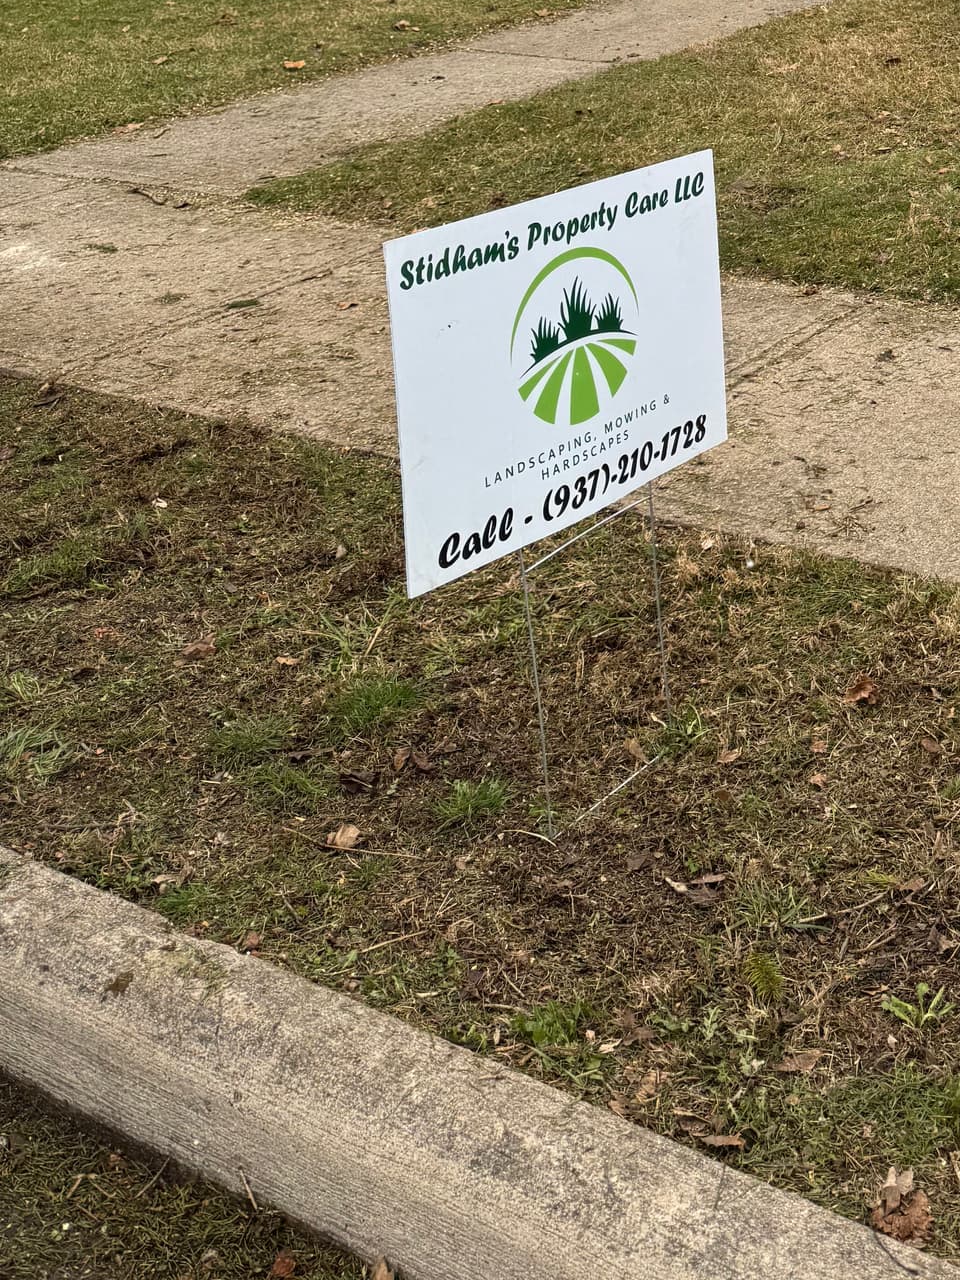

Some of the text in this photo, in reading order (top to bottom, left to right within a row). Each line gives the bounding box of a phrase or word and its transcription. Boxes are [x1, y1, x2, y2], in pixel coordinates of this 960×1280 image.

[399, 171, 705, 290] Stidham's Property Care LLC
[438, 507, 514, 569] Call
[542, 414, 707, 522] (937)-210-1728
[484, 393, 671, 488] LANDSCAPING, MOWING &
[541, 429, 630, 480] HARDSCAPES
